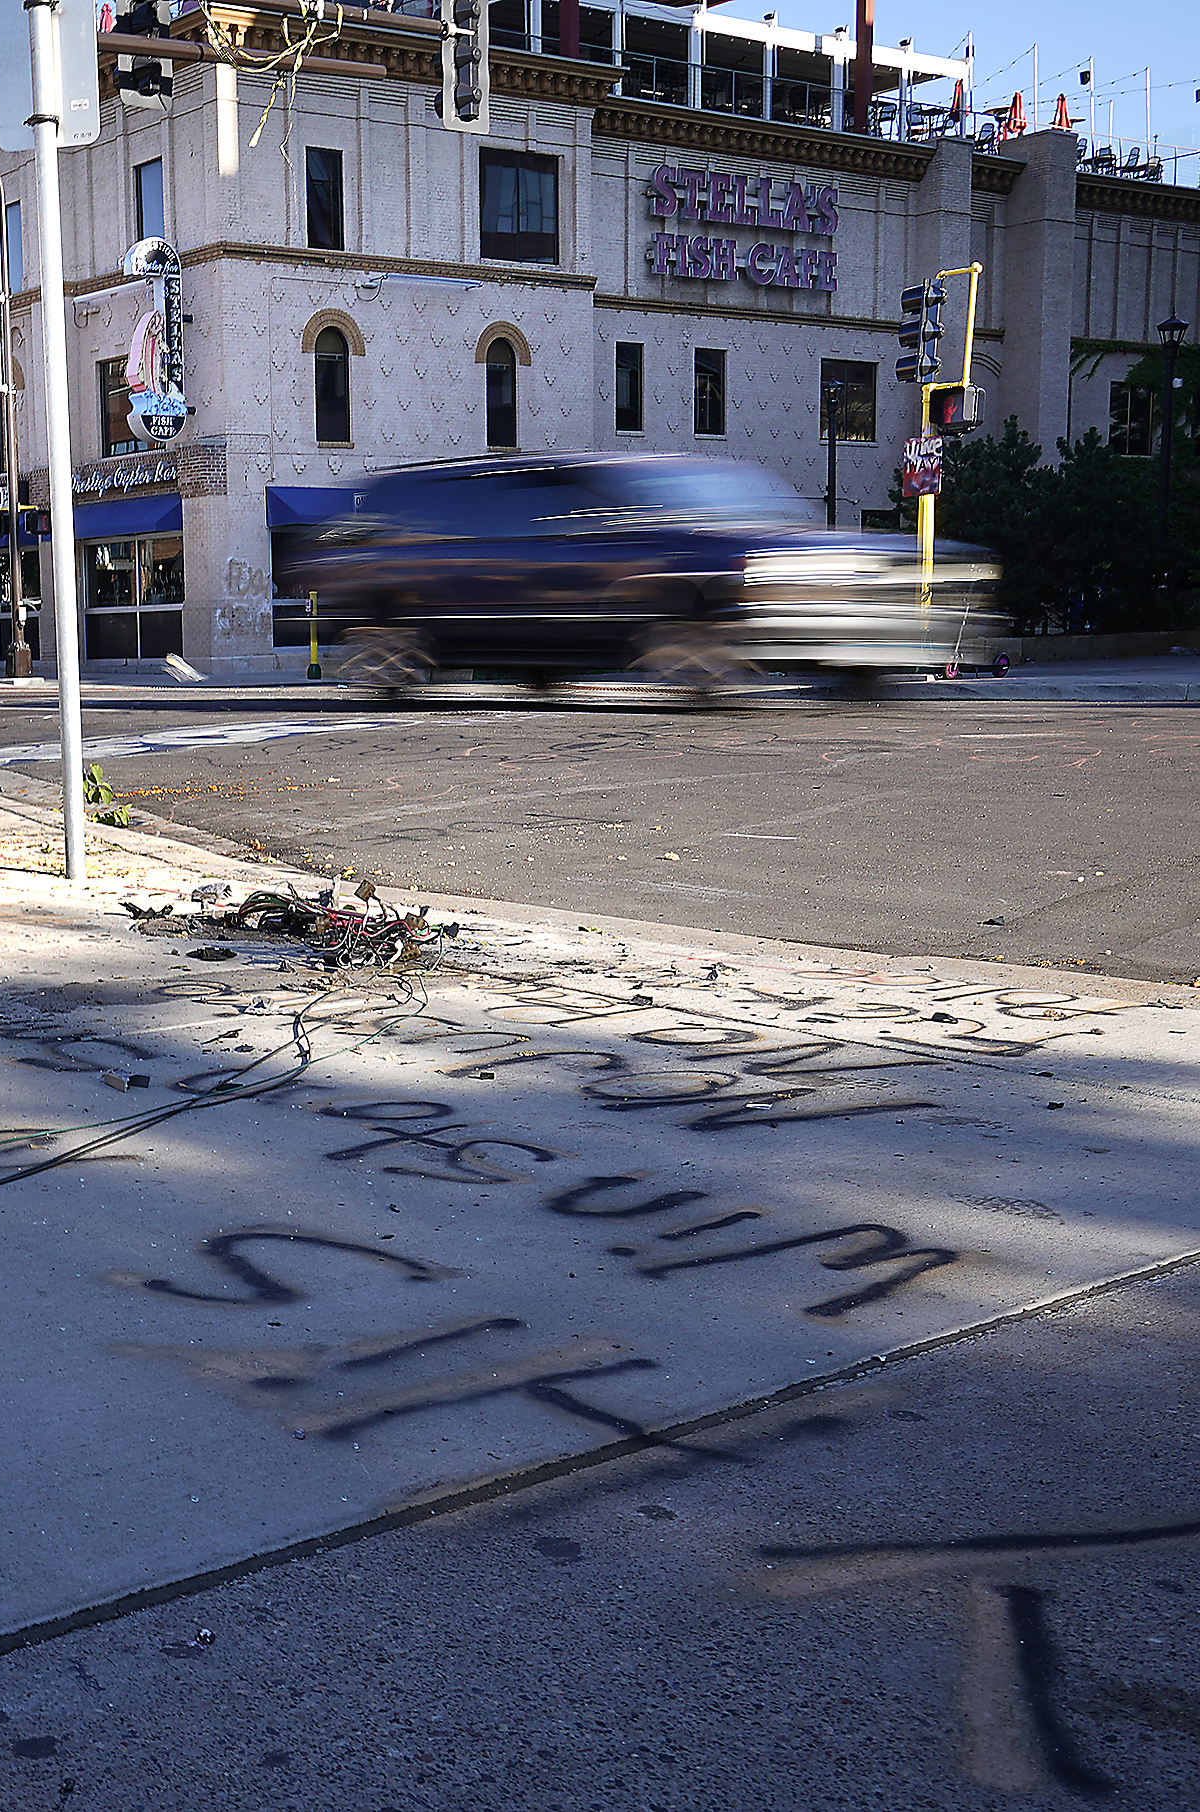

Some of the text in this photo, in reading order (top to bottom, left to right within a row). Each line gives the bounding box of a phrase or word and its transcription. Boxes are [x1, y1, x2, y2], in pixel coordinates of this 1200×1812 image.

[651, 164, 839, 236] STELLA'S
[651, 232, 838, 292] FISH CAFE
[150, 416, 173, 425] FISH
[151, 426, 176, 436] CAFE
[114, 465, 150, 494] Oyster
